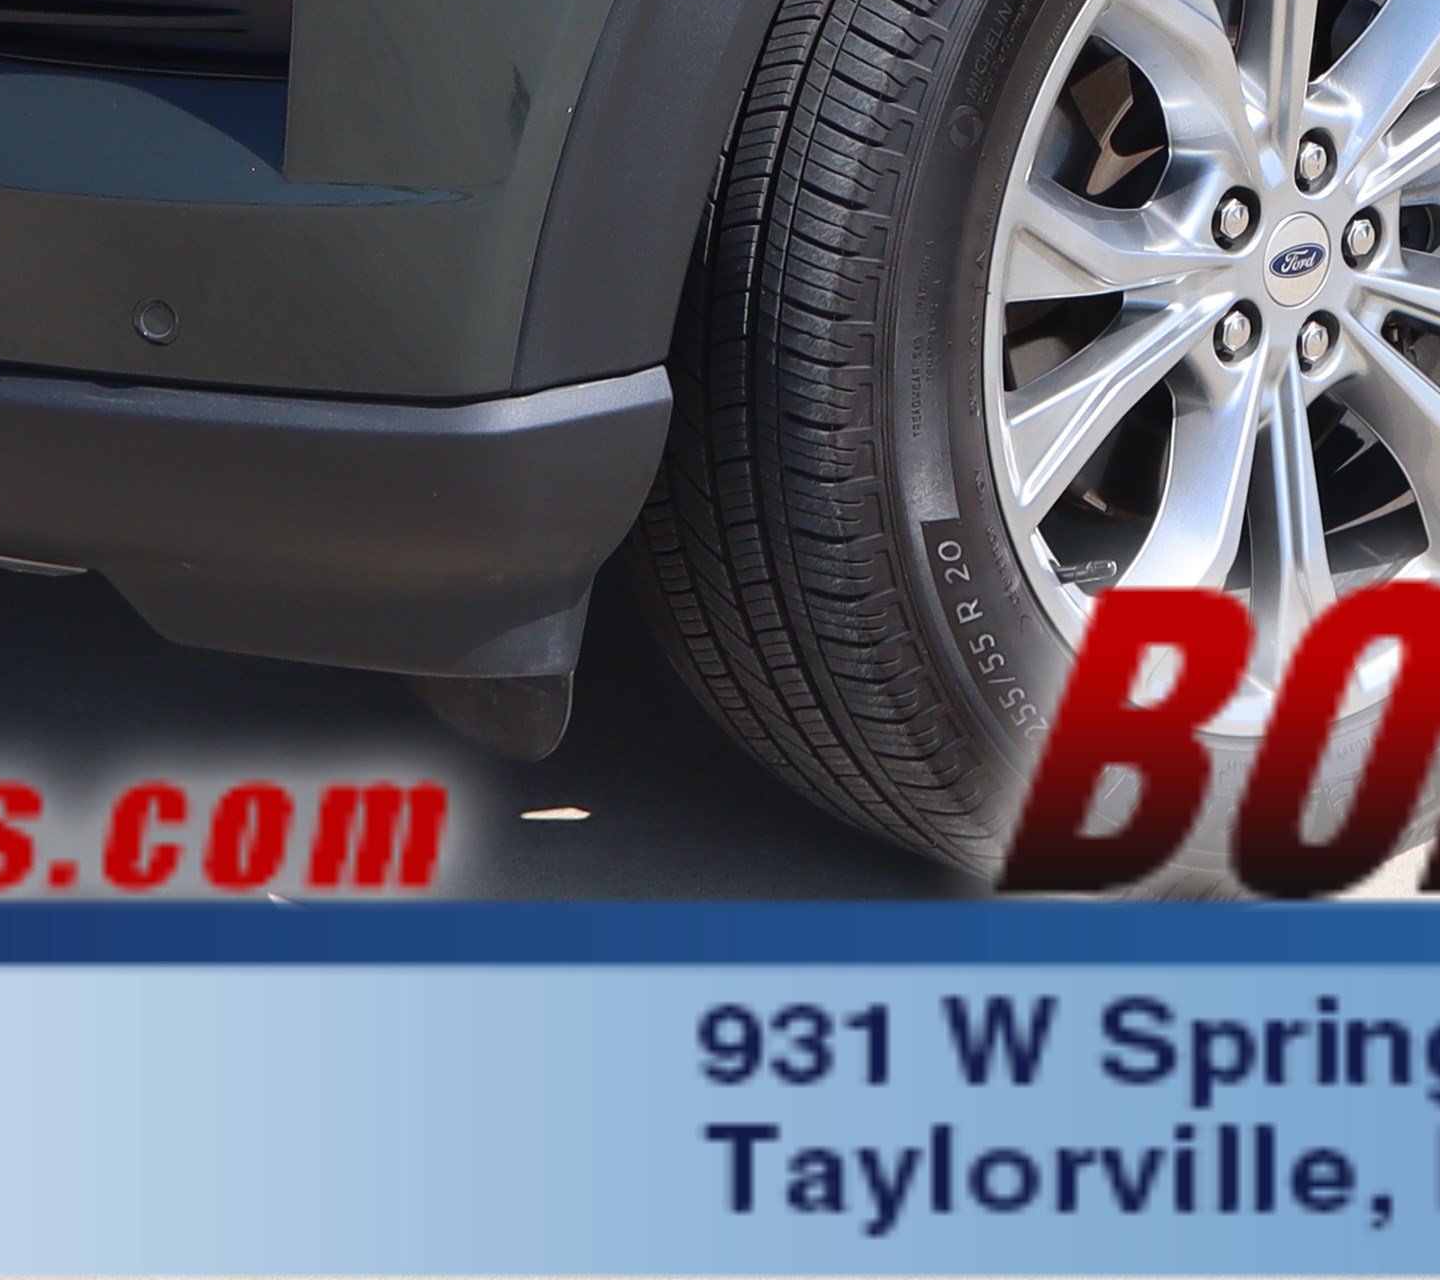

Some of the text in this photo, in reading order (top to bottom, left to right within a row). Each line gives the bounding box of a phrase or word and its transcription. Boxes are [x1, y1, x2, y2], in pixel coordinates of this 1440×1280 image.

[965, 1, 1014, 99] MICHELIN
[1280, 249, 1317, 273] Ford
[937, 540, 971, 585] 20
[956, 598, 984, 624] R
[969, 633, 1051, 741] 255/55
